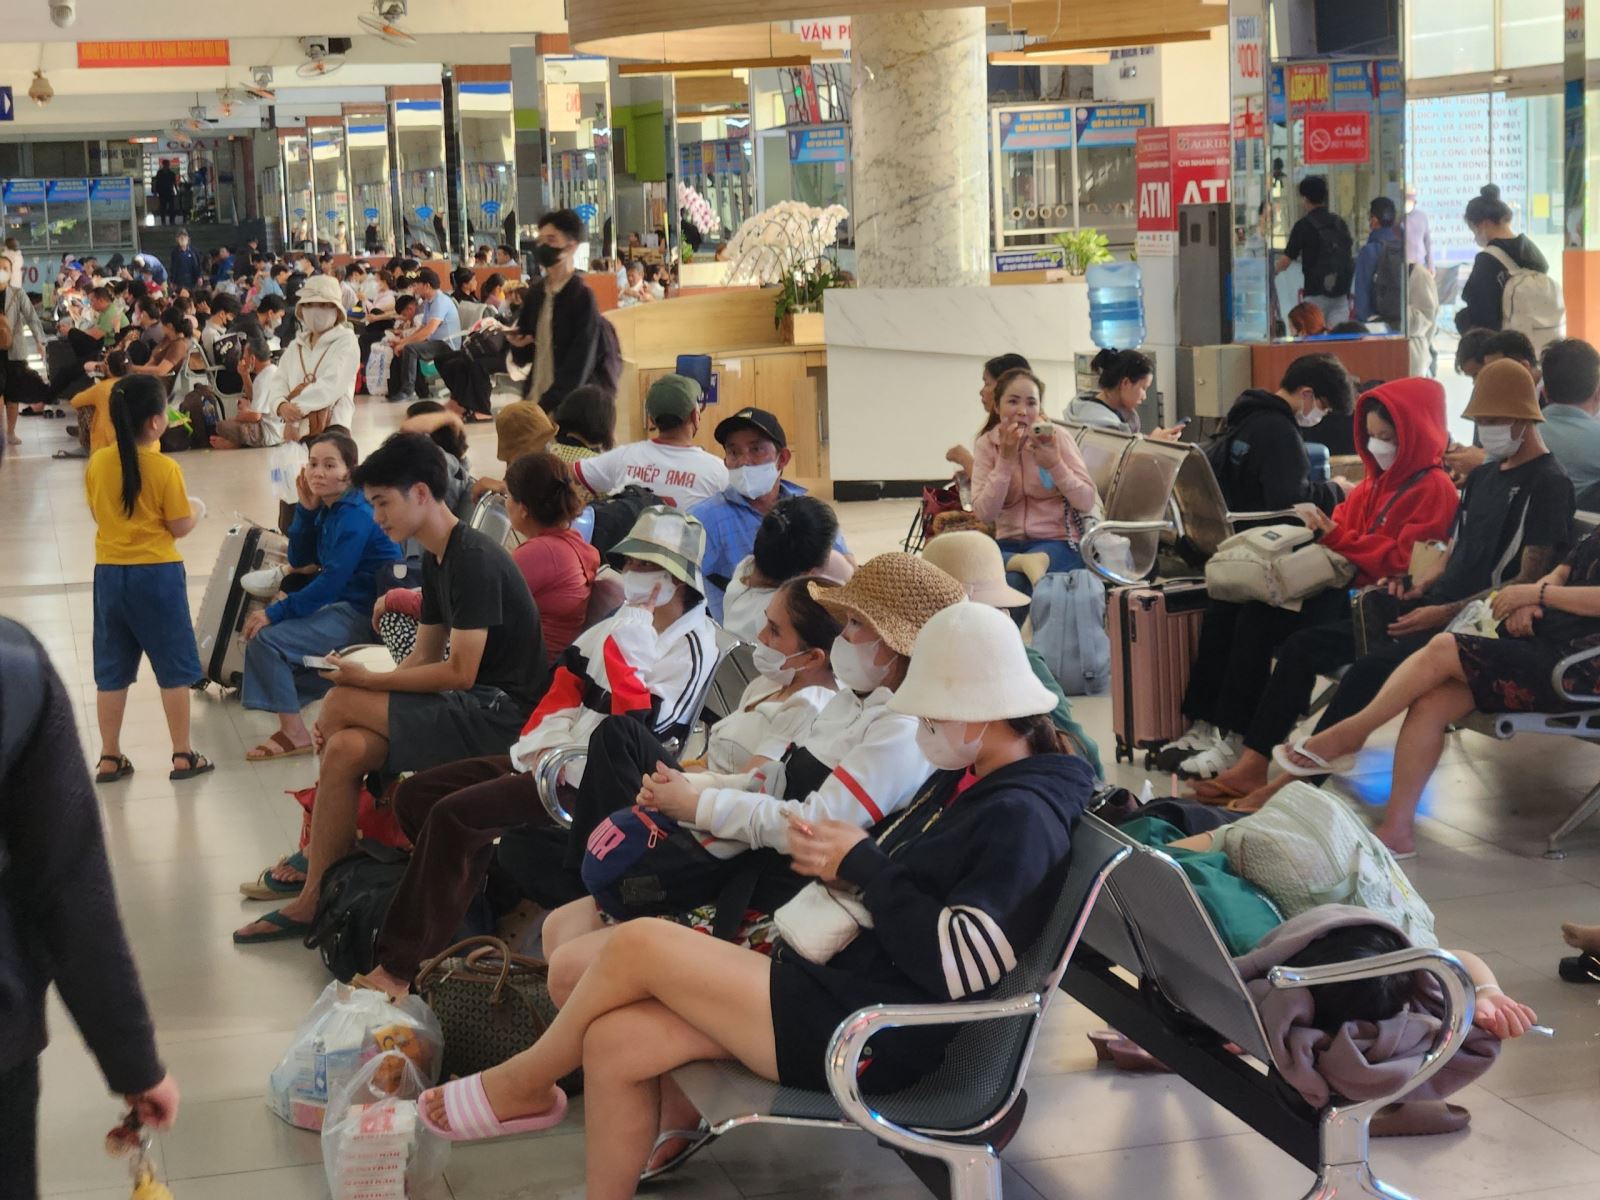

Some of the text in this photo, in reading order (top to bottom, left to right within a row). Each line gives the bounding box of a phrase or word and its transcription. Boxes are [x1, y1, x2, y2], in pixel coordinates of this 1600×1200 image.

[801, 22, 831, 40] VĂN
[1335, 124, 1361, 136] CẤM
[1139, 182, 1170, 218] ATM
[1183, 179, 1231, 205] AT
[627, 463, 696, 488] THIẾP AMA
